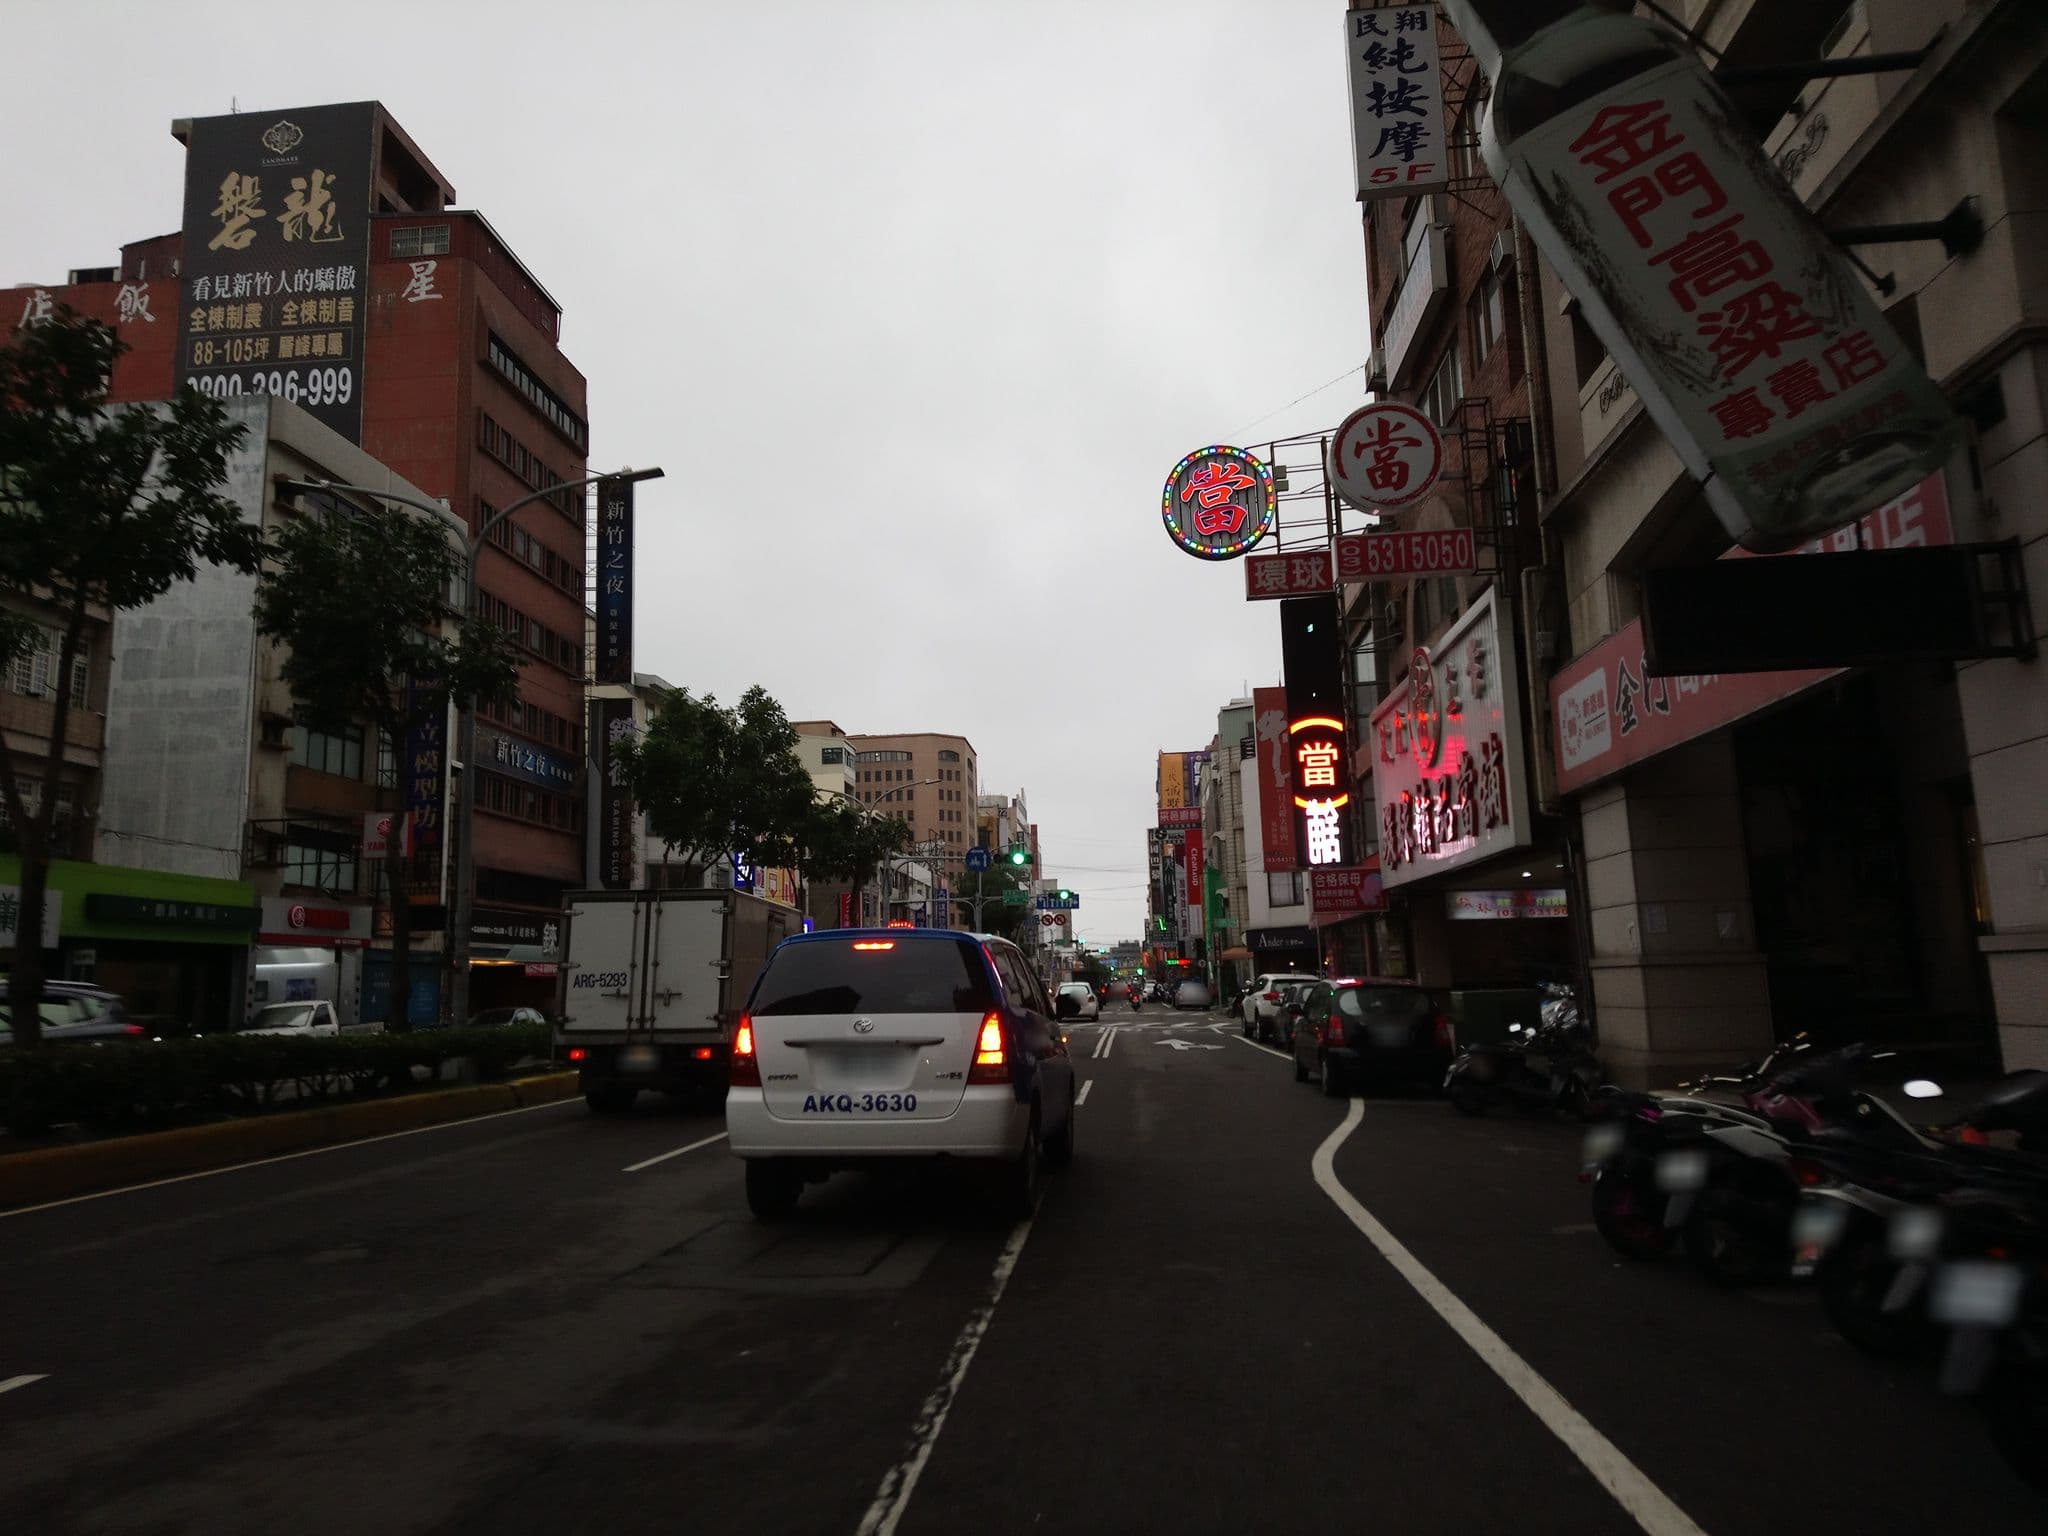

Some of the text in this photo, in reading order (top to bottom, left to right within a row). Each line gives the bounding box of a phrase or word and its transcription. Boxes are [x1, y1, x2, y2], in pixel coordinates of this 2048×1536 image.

[1363, 37, 1431, 162] 純按摩
[1369, 164, 1436, 184] 5F
[191, 265, 357, 302] 看見新竹人的驕傲
[400, 260, 444, 305] 星
[1708, 330, 1888, 440] 專賣店
[1354, 416, 1424, 491] 當
[1180, 462, 1258, 536] 當
[605, 501, 626, 595] 新竹之夜
[1367, 532, 1469, 572] 5315050
[1255, 555, 1328, 594] 環球
[573, 971, 627, 993] ARG-5293
[803, 1094, 917, 1113] AKQ-3630
